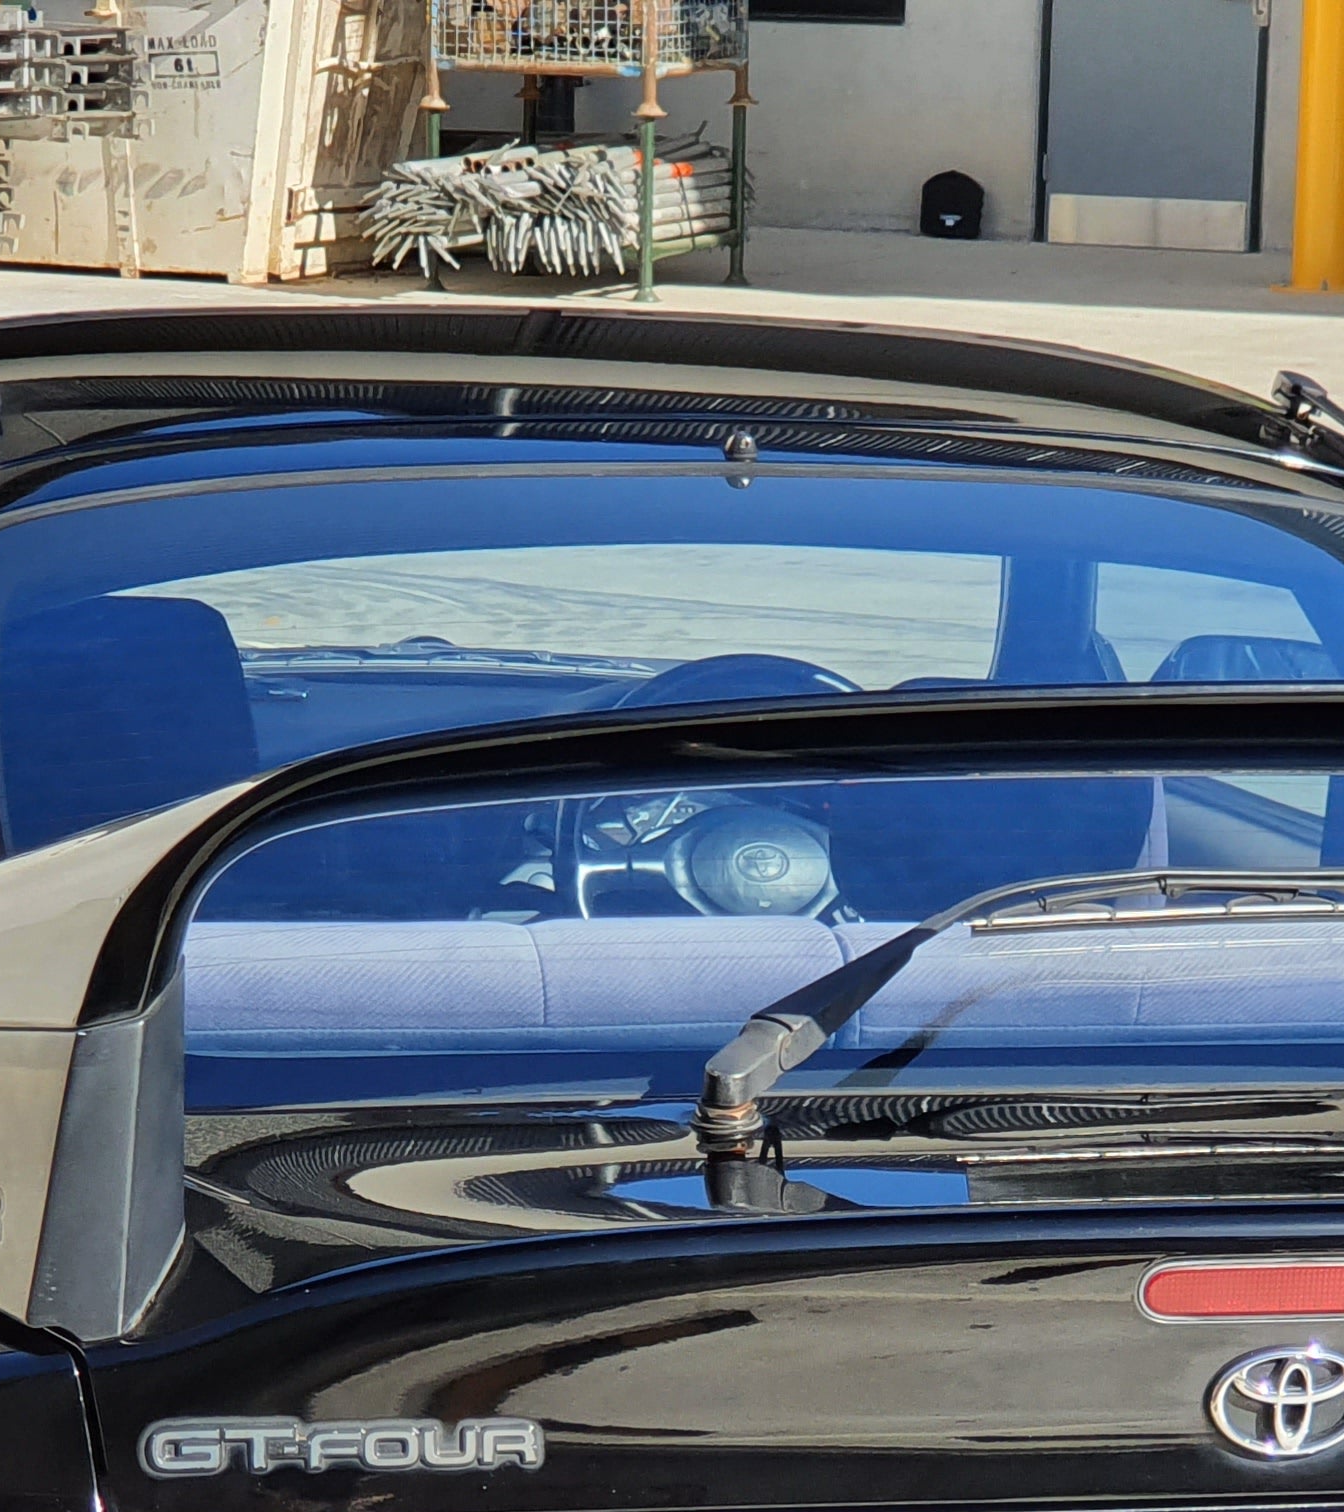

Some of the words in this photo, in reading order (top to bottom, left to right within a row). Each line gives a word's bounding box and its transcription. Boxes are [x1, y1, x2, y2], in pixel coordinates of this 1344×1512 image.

[147, 36, 174, 50] MAX
[182, 34, 217, 49] LOAD
[146, 1422, 542, 1474] GT-FOUR
